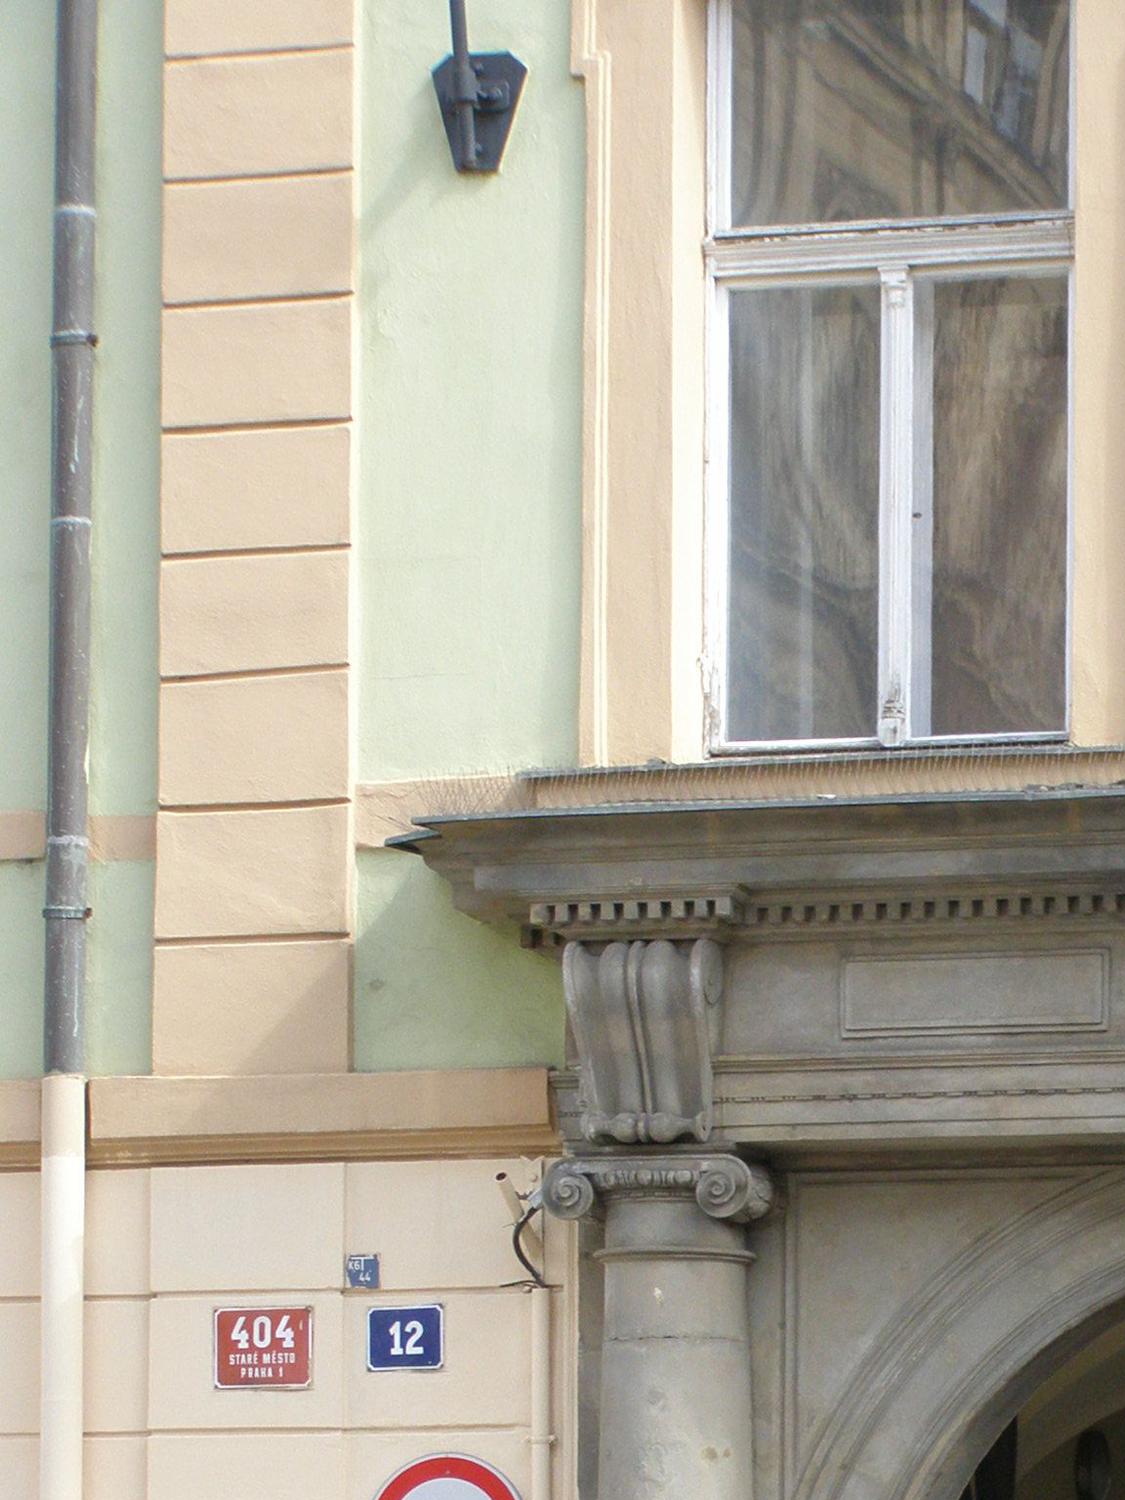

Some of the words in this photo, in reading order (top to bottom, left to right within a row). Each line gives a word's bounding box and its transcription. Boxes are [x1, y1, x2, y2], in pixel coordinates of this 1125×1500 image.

[231, 1315, 294, 1349] 404
[389, 1320, 425, 1356] 12
[228, 1351, 258, 1366] STARÉ
[240, 1367, 273, 1378] PRAHA
[279, 1366, 284, 1377] 1
